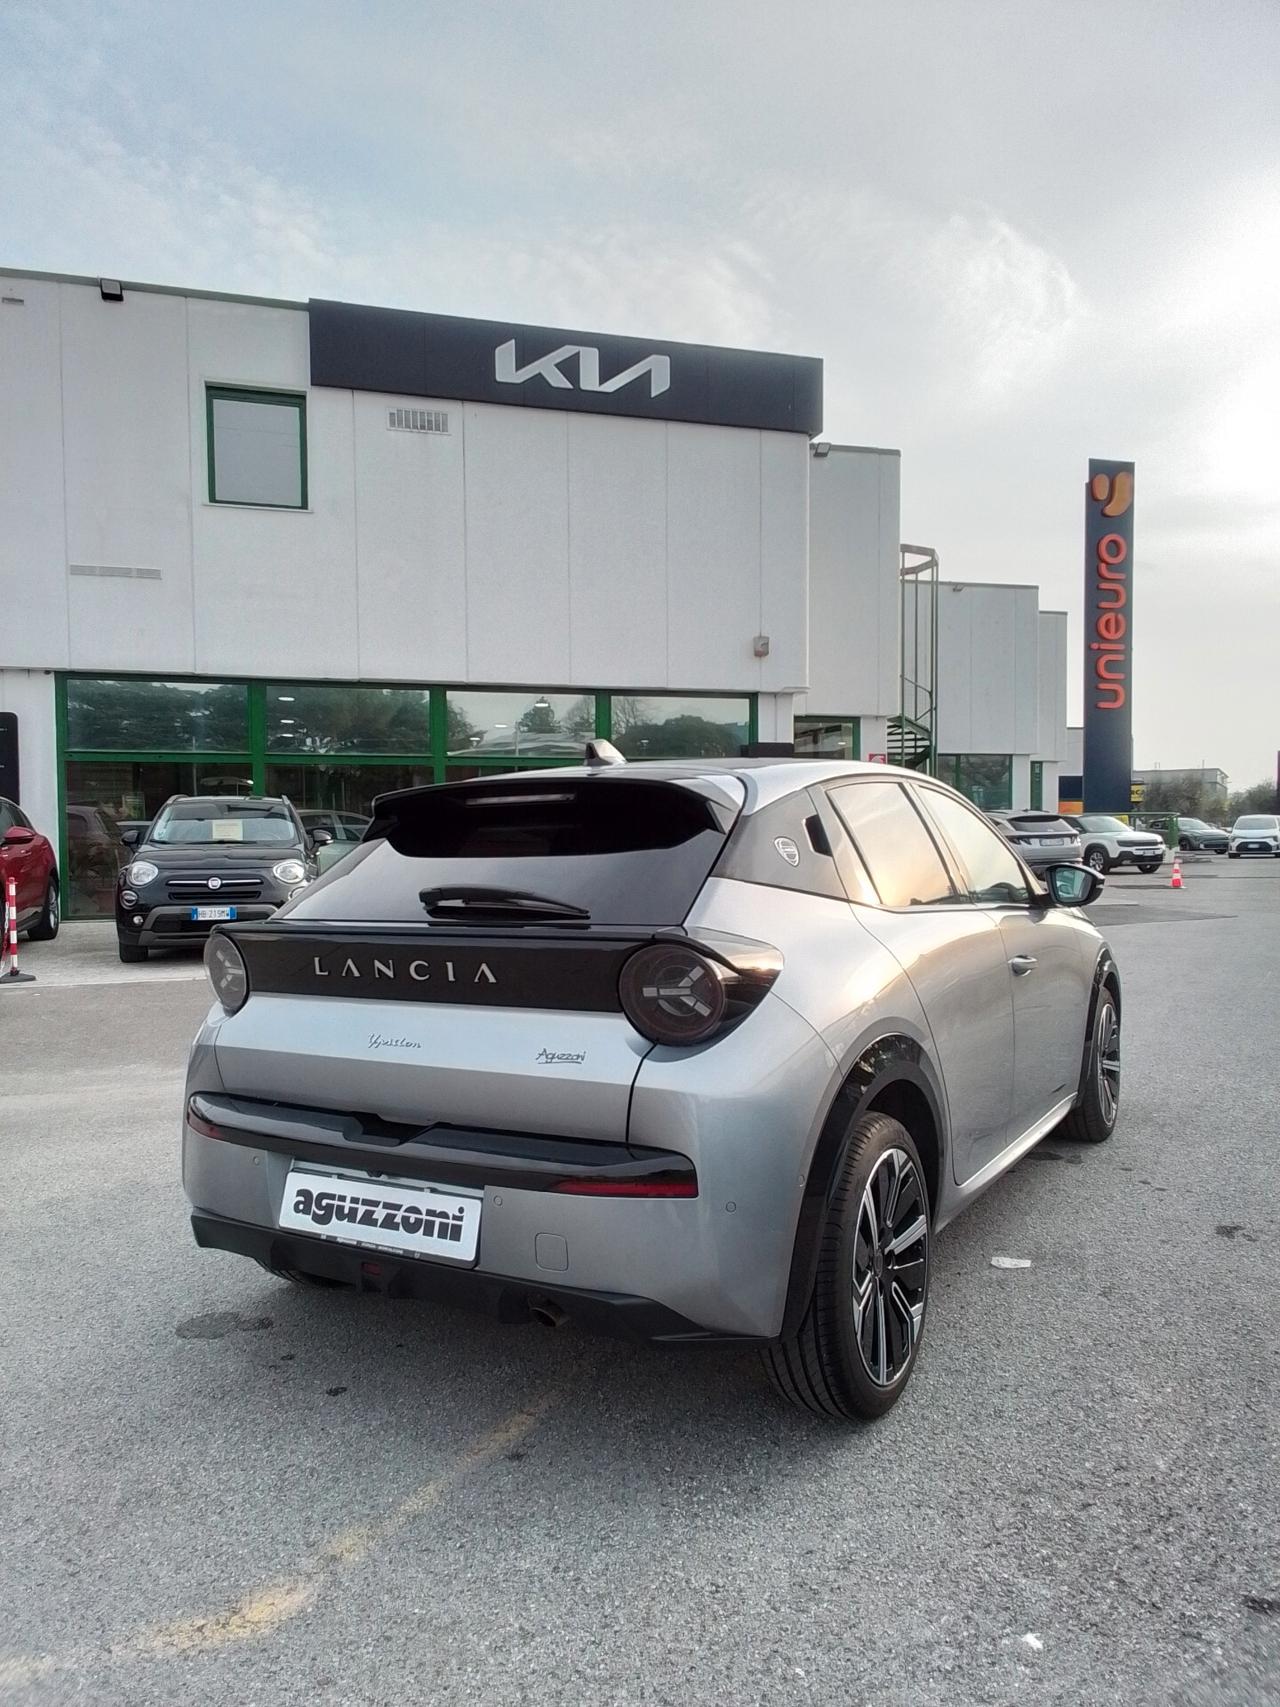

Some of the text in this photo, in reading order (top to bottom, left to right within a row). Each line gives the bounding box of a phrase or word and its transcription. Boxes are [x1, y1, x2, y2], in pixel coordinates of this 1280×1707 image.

[495, 338, 671, 399] KIA
[1090, 533, 1127, 709] unieuro
[313, 956, 498, 984] LANCIA
[293, 1188, 465, 1243] aguzzoni
